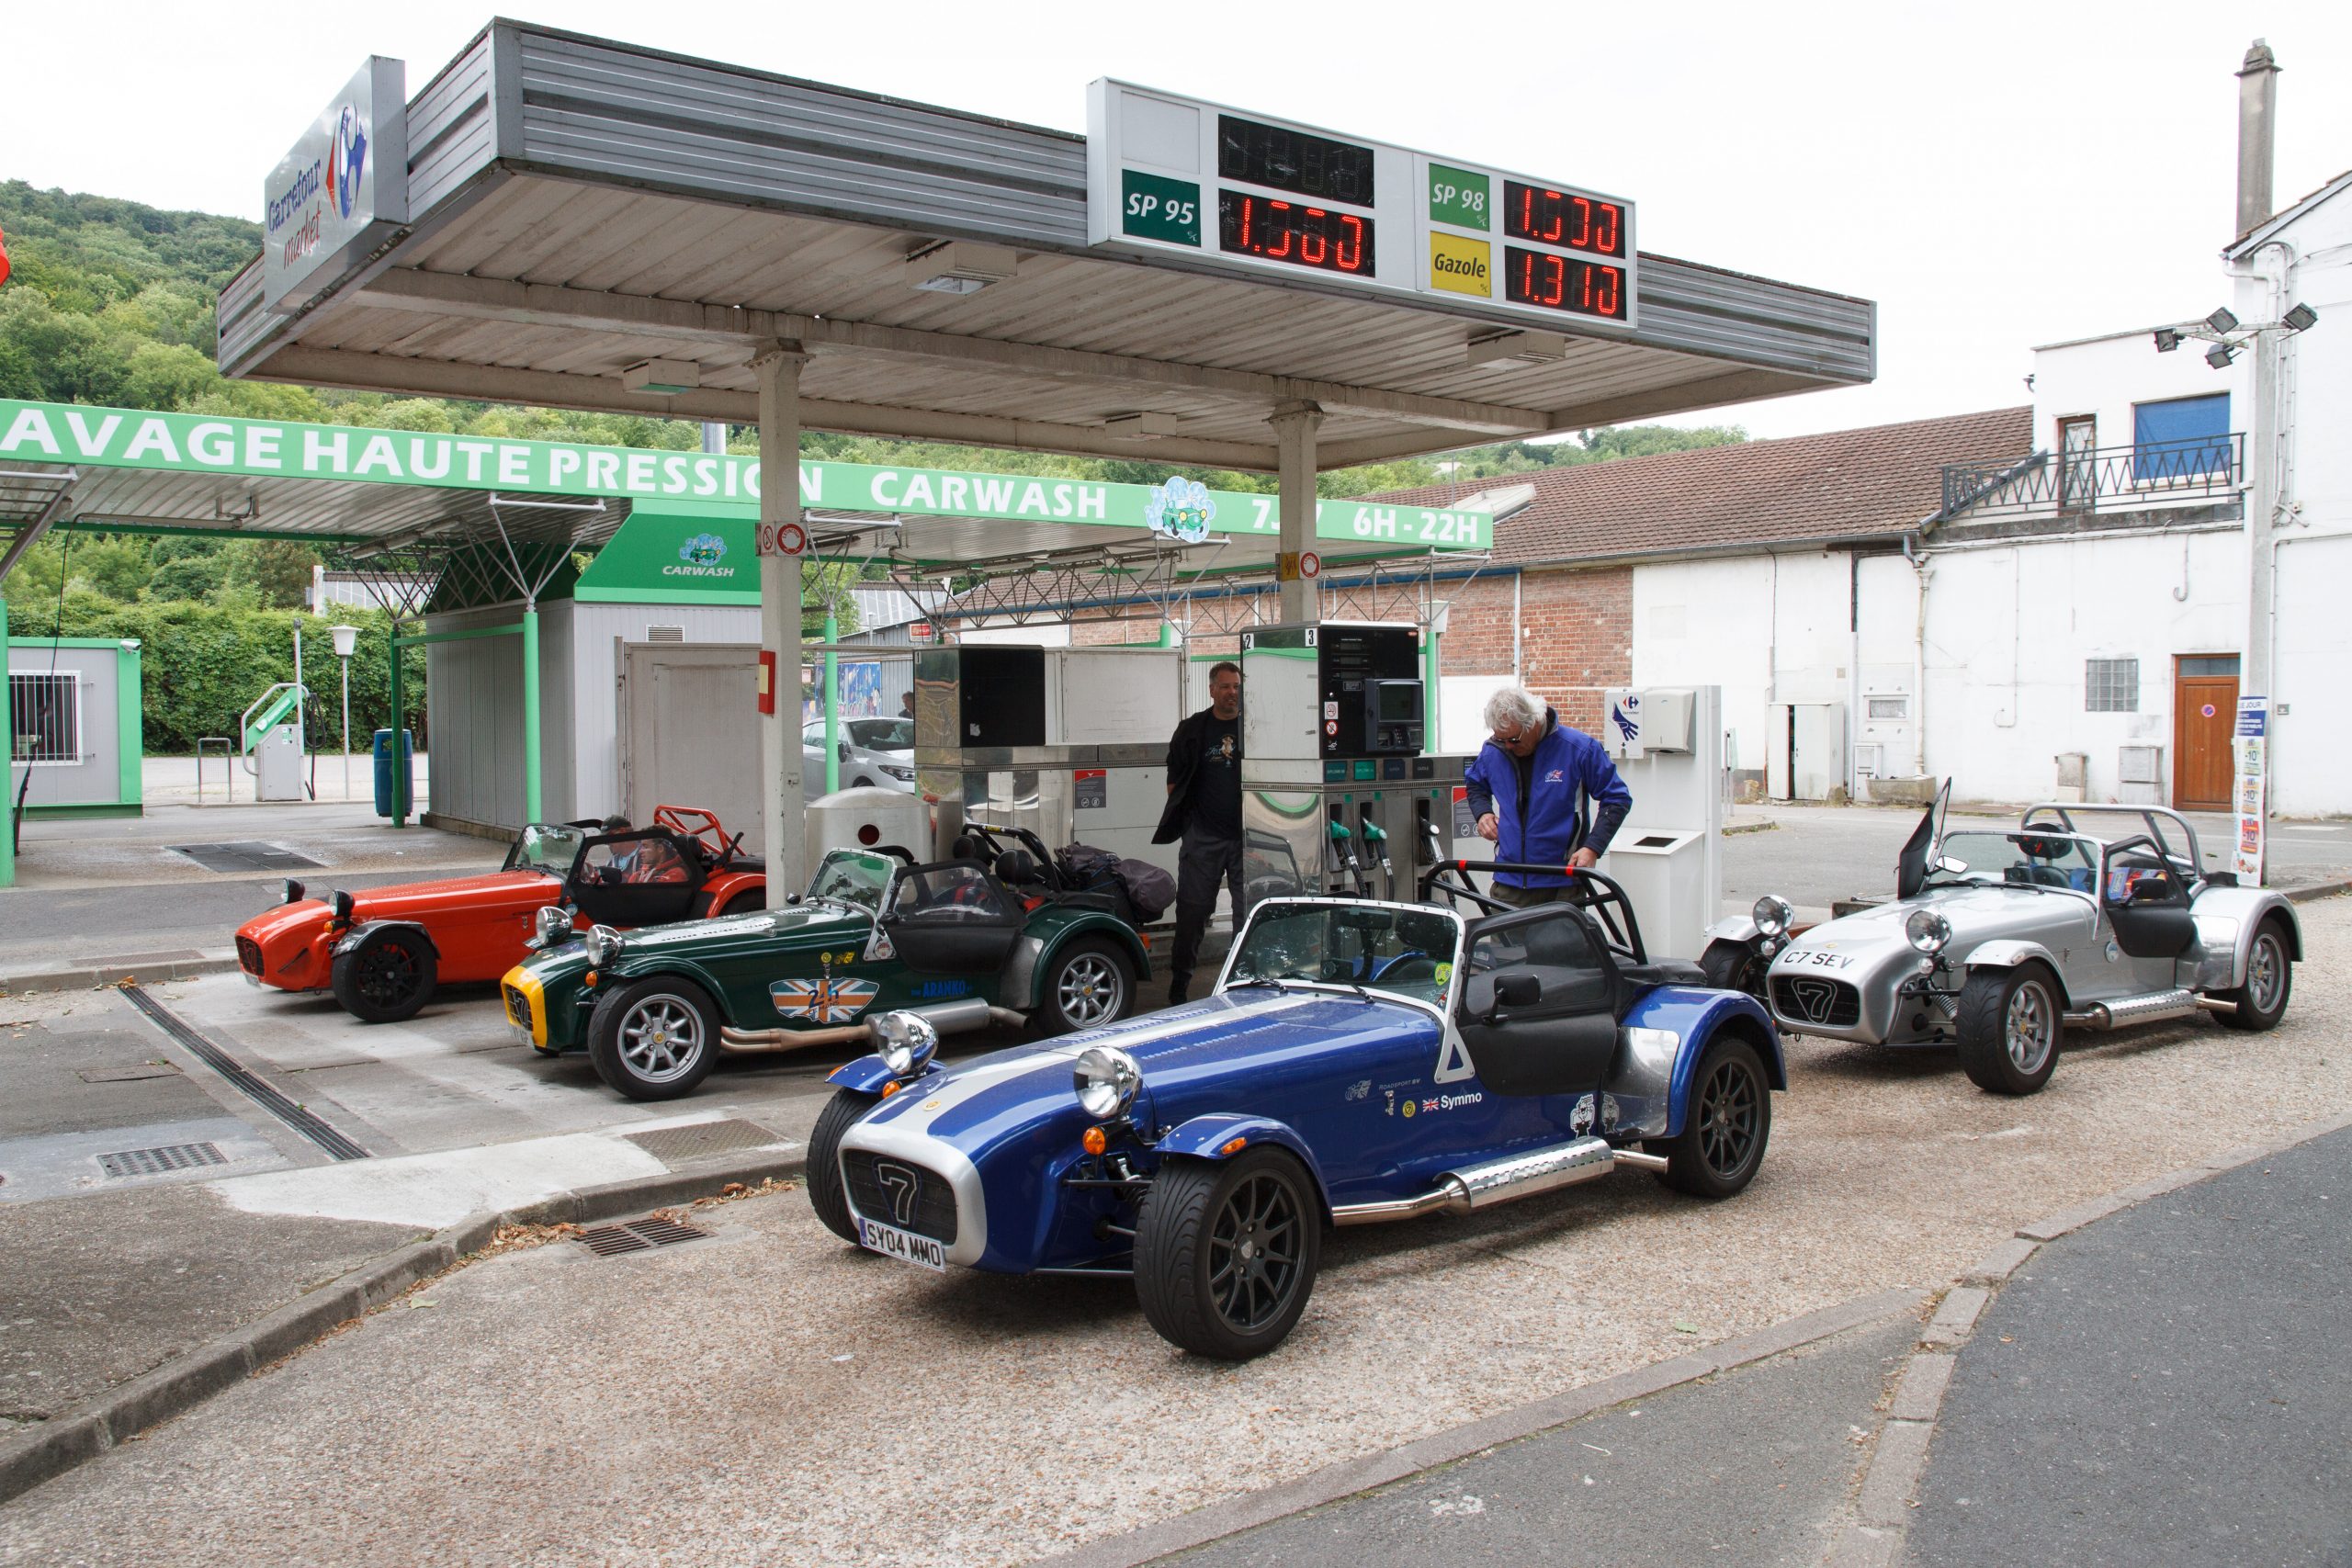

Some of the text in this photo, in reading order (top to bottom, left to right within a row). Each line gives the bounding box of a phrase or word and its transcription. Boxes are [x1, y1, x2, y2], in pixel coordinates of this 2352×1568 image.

[268, 159, 321, 235] Carrefour
[1126, 192, 1195, 224] SP 95
[1432, 183, 1486, 211] SP 98
[283, 199, 322, 270] market
[1434, 253, 1487, 277] Gazole
[1524, 254, 1618, 314] 1.310
[0, 408, 284, 469] AVAGE
[303, 430, 532, 484] HAUTE
[870, 471, 1106, 519] CARWASH
[1353, 507, 1396, 537] 6H
[1419, 512, 1478, 544] 22H
[662, 565, 735, 577] CARWASH
[1246, 635, 1251, 649] 2
[1308, 629, 1314, 645] 3
[1784, 952, 1854, 969] C7 SEV
[1797, 981, 1832, 1019] 7
[1379, 1080, 1411, 1090] ROADSPORT
[1441, 1092, 1482, 1111] Symmo
[878, 1163, 917, 1224] 7
[867, 1224, 941, 1267] SY04 MMO
